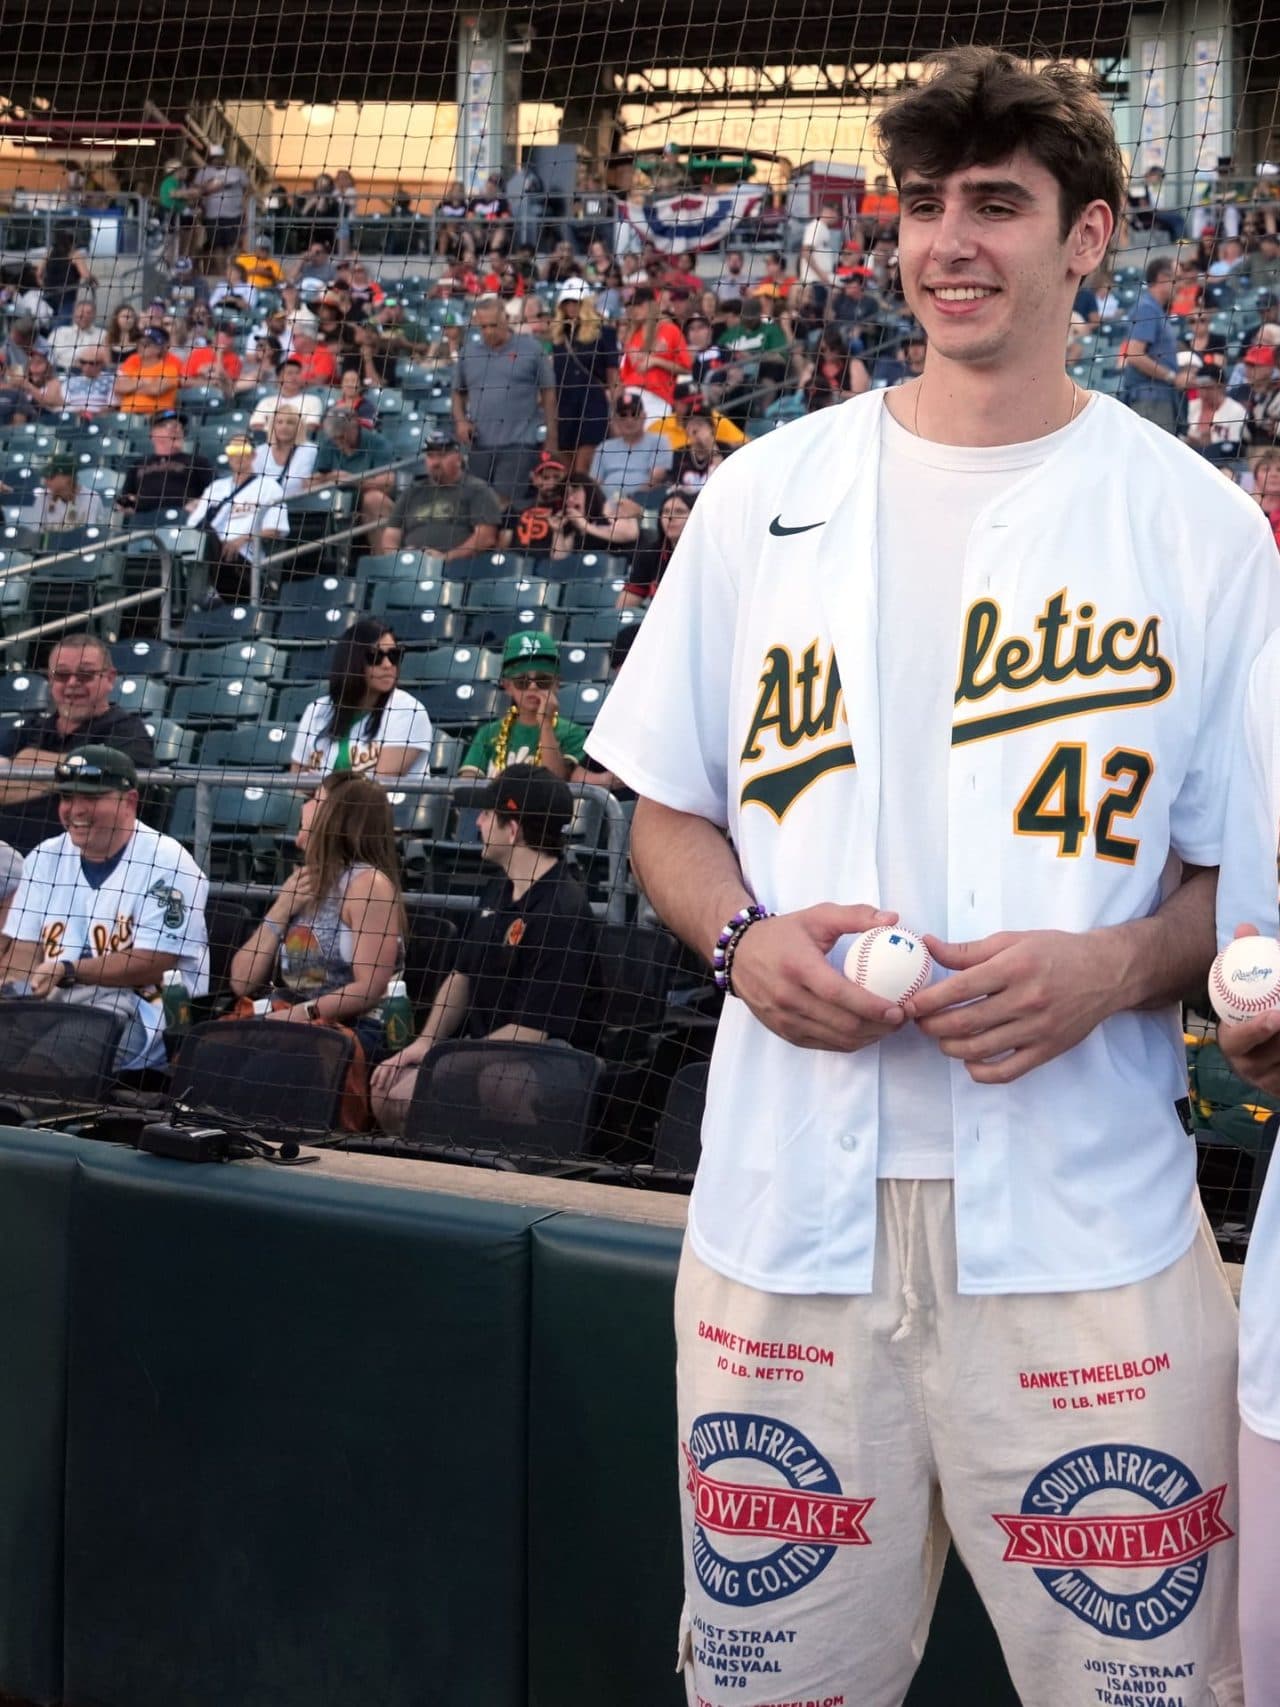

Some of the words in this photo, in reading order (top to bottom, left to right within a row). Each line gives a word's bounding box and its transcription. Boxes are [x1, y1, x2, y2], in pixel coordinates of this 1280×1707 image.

[952, 586, 1175, 704] letics
[1013, 742, 1154, 866] 42
[1231, 965, 1273, 982] Rawlings
[698, 1320, 834, 1367] BANKETMEELBLOM
[731, 1367, 751, 1379] LB.
[755, 1367, 804, 1382] NETTO
[1020, 1353, 1170, 1388] BANKETMEELBLOM
[1072, 1397, 1093, 1409] LB.
[1097, 1387, 1145, 1405] NETTO
[691, 1420, 740, 1465] SOUTH
[744, 1421, 828, 1488] AFRICAN
[1032, 1454, 1101, 1514] SOUTH
[1104, 1451, 1190, 1506] AFRICAN
[698, 1486, 849, 1537] OWFLAKE
[1019, 1505, 1213, 1559] SNOWFLAKE
[694, 1524, 740, 1598] MILLING
[1050, 1571, 1131, 1631] MILLING
[703, 1639, 766, 1658] ISANDO
[727, 1630, 798, 1645] STRAAT
[694, 1647, 782, 1673] TRANSVAAL
[1084, 1659, 1126, 1677] JOIST
[1129, 1662, 1196, 1678] STRAAT
[714, 1674, 747, 1688] M78
[1107, 1677, 1167, 1693] ISANDO
